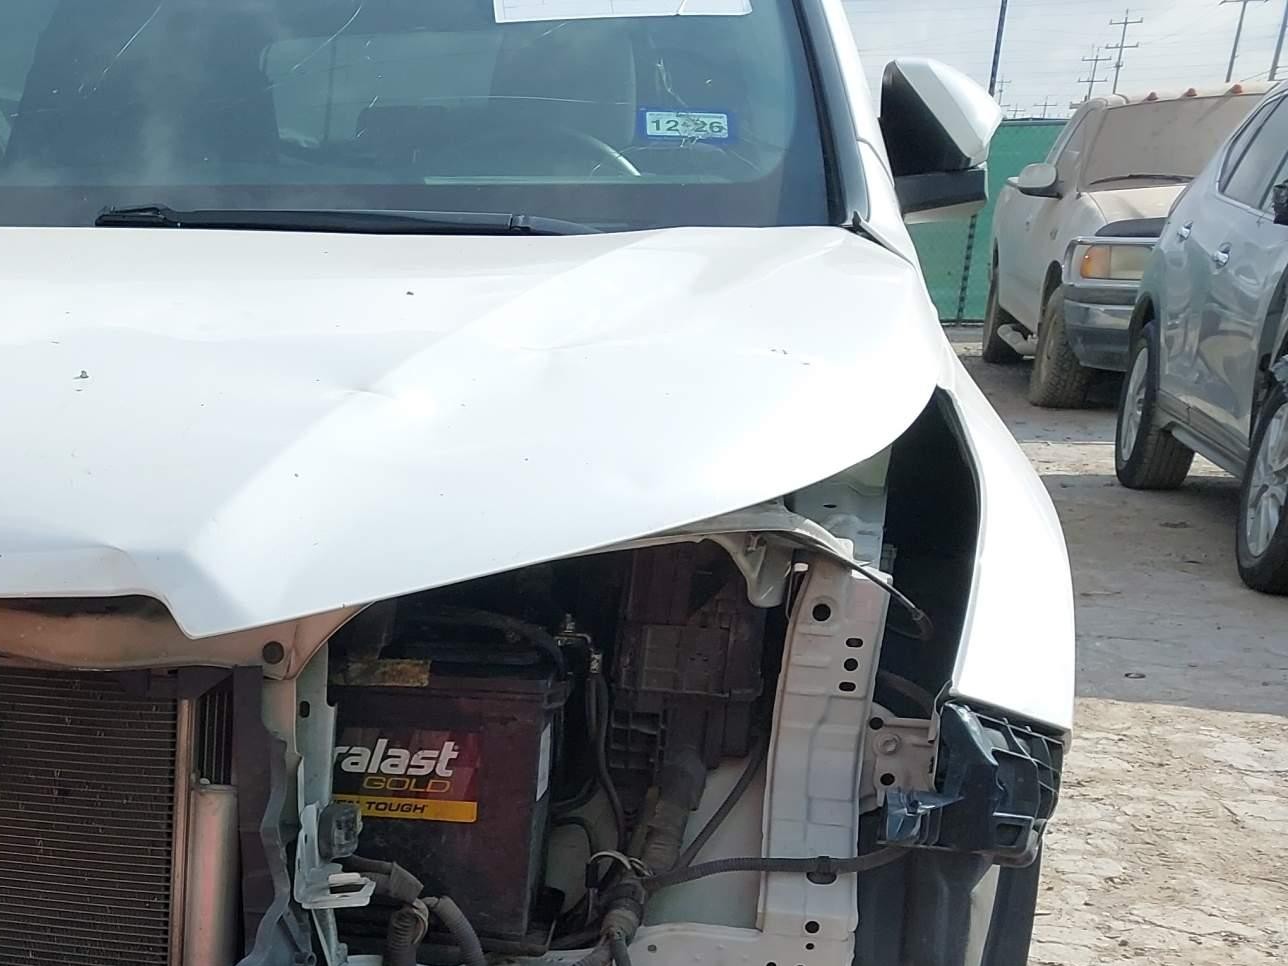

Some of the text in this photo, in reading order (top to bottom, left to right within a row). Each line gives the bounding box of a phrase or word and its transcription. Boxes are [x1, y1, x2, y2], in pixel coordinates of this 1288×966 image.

[333, 738, 460, 777] ralast
[362, 775, 452, 793] GOLD
[365, 801, 429, 814] TOUGH
